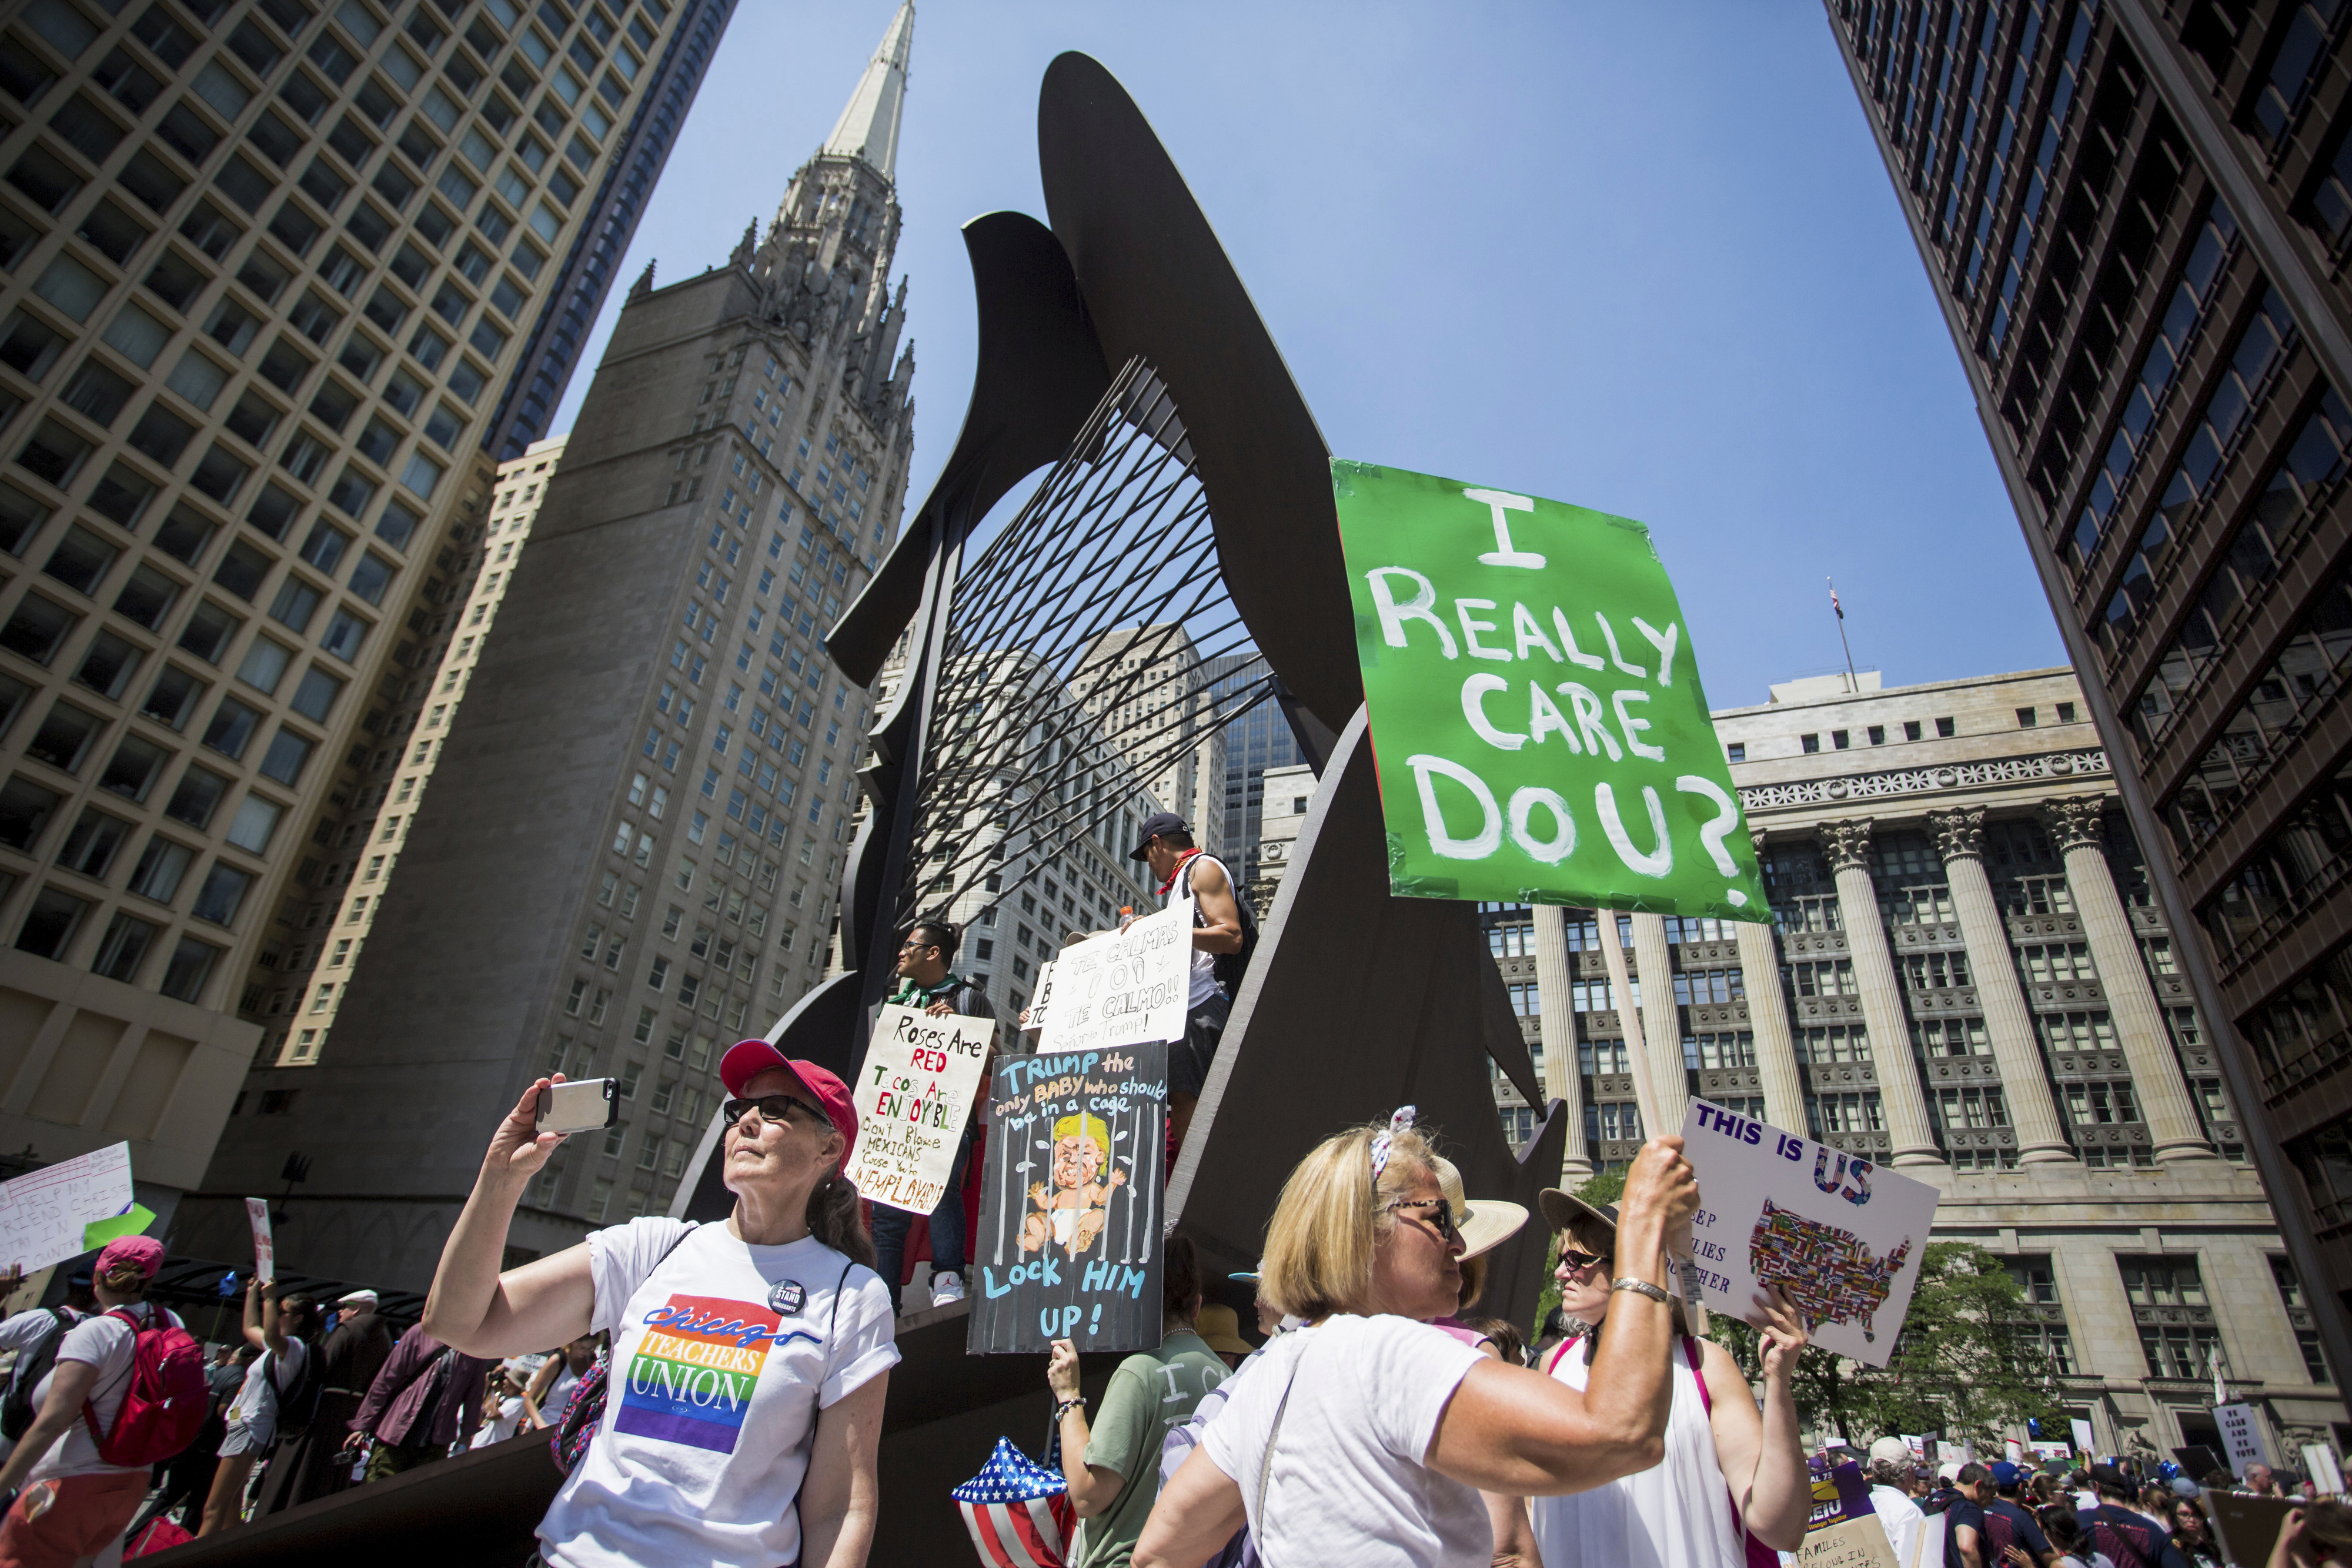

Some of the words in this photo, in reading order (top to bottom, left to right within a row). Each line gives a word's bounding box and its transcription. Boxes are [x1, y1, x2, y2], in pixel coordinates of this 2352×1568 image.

[1462, 488, 1546, 570] I
[1365, 565, 1678, 687] REALLY
[1461, 673, 1665, 763] CARE
[1071, 950, 1101, 975] TE
[1106, 920, 1178, 963] CALMAS
[1064, 1004, 1091, 1029] TE
[910, 1048, 947, 1073] RED
[1000, 1052, 1099, 1095] TRUMP
[1101, 1052, 1135, 1073] the
[876, 1092, 961, 1132] ENJOYABLE
[995, 1094, 1031, 1117] only
[1034, 1075, 1085, 1104] BABY
[1084, 1078, 1118, 1095] who
[1119, 1075, 1167, 1101] should
[1009, 1111, 1037, 1131] be
[1041, 1101, 1060, 1118] in
[1065, 1098, 1079, 1112] a
[1089, 1096, 1131, 1116] cage
[867, 1136, 923, 1162] MEXICANS
[1696, 1103, 1762, 1145] THIS
[1776, 1134, 1803, 1162] IS
[1813, 1146, 1874, 1207] US
[15, 1188, 61, 1216] HELP
[68, 1178, 89, 1195] MY
[776, 1289, 800, 1303] STAND
[983, 1254, 1062, 1299] LOCK
[1081, 1259, 1146, 1299] HIM
[772, 1301, 796, 1312] IMMIGRANTS
[643, 1332, 760, 1373] TEACHERS
[632, 1356, 750, 1413] UNION
[1823, 1472, 1833, 1480] 73
[1828, 1514, 1847, 1524] Together
[1847, 1547, 1865, 1562] IN
